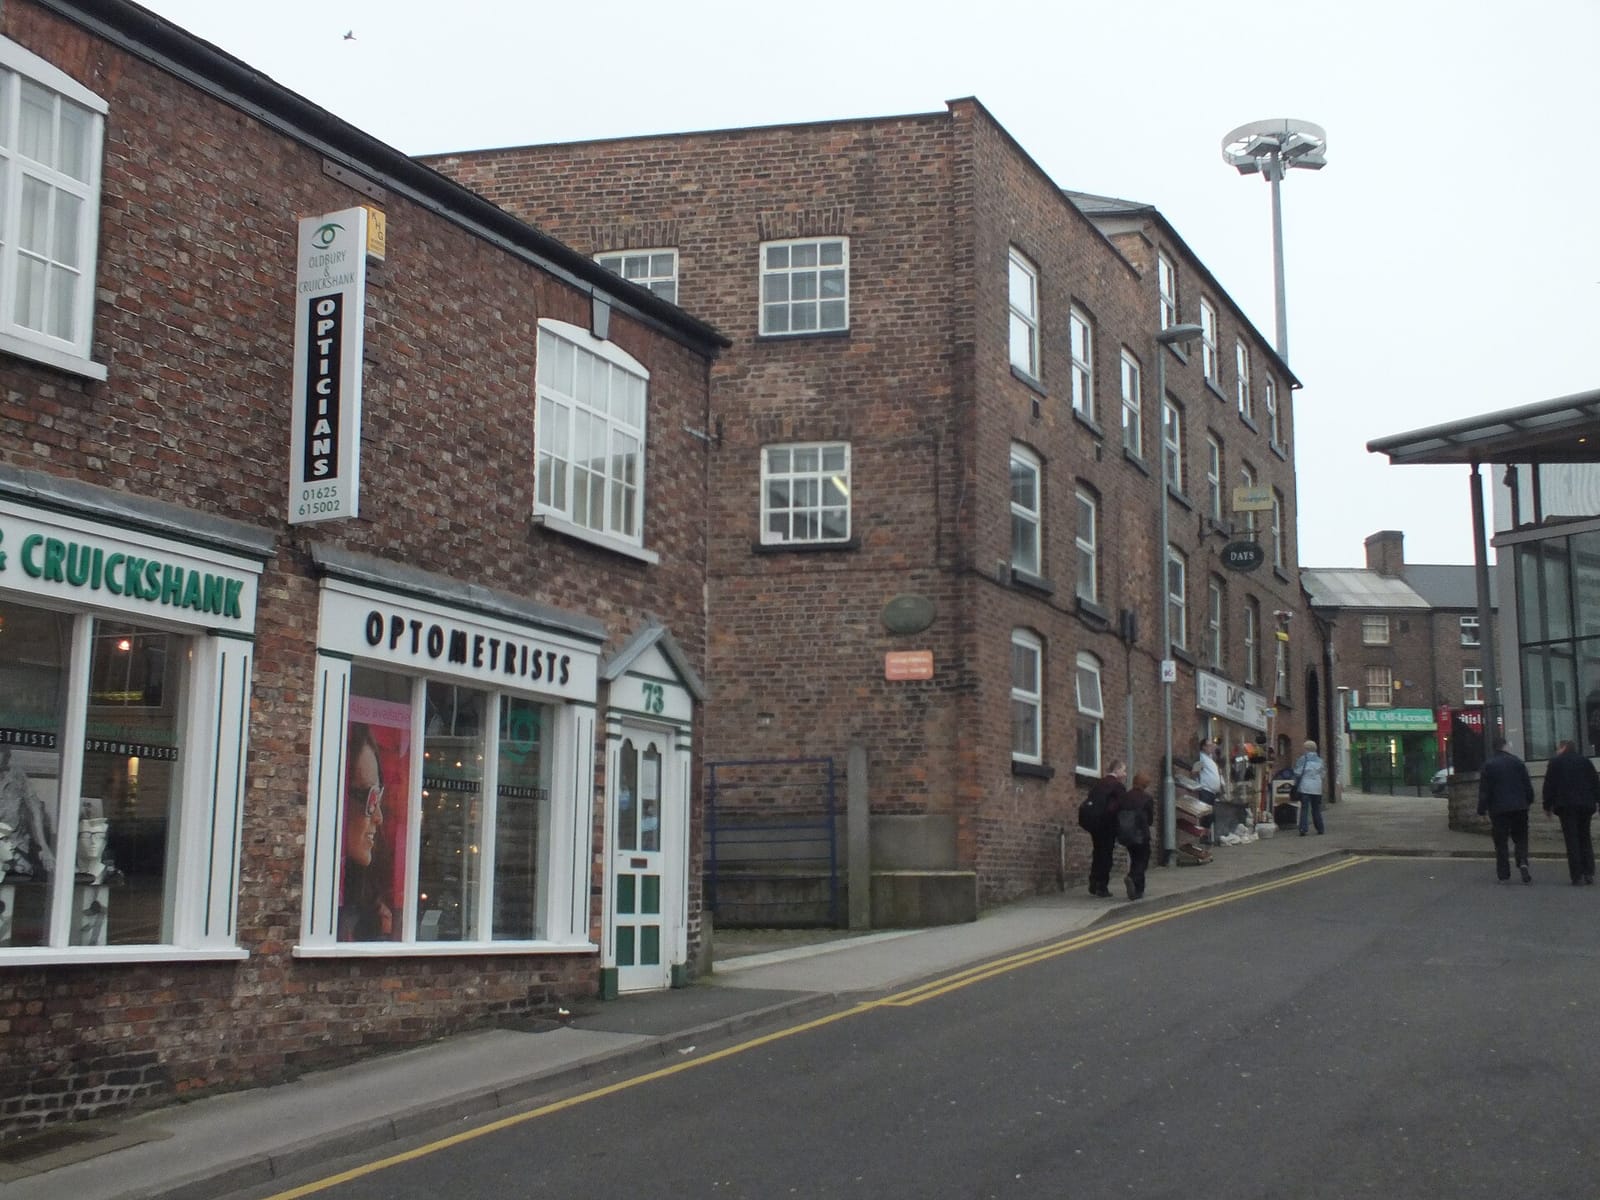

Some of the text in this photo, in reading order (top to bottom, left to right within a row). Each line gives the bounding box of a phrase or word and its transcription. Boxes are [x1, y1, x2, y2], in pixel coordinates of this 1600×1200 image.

[308, 250, 347, 268] OLDBURY
[323, 266, 330, 277] &
[298, 272, 355, 293] CRUICKSHANK
[312, 299, 336, 476] OPTICIANS
[302, 486, 337, 501] 01625
[298, 500, 341, 516] 615002
[1230, 551, 1255, 561] DAYS
[21, 533, 245, 619] CRUICKSHANK
[365, 610, 571, 685] OPTOMETRISTS
[641, 682, 665, 714] 73
[1226, 685, 1245, 711] DAYS
[1348, 710, 1378, 721] STAR
[86, 740, 177, 759] OPTOMETRISTS
